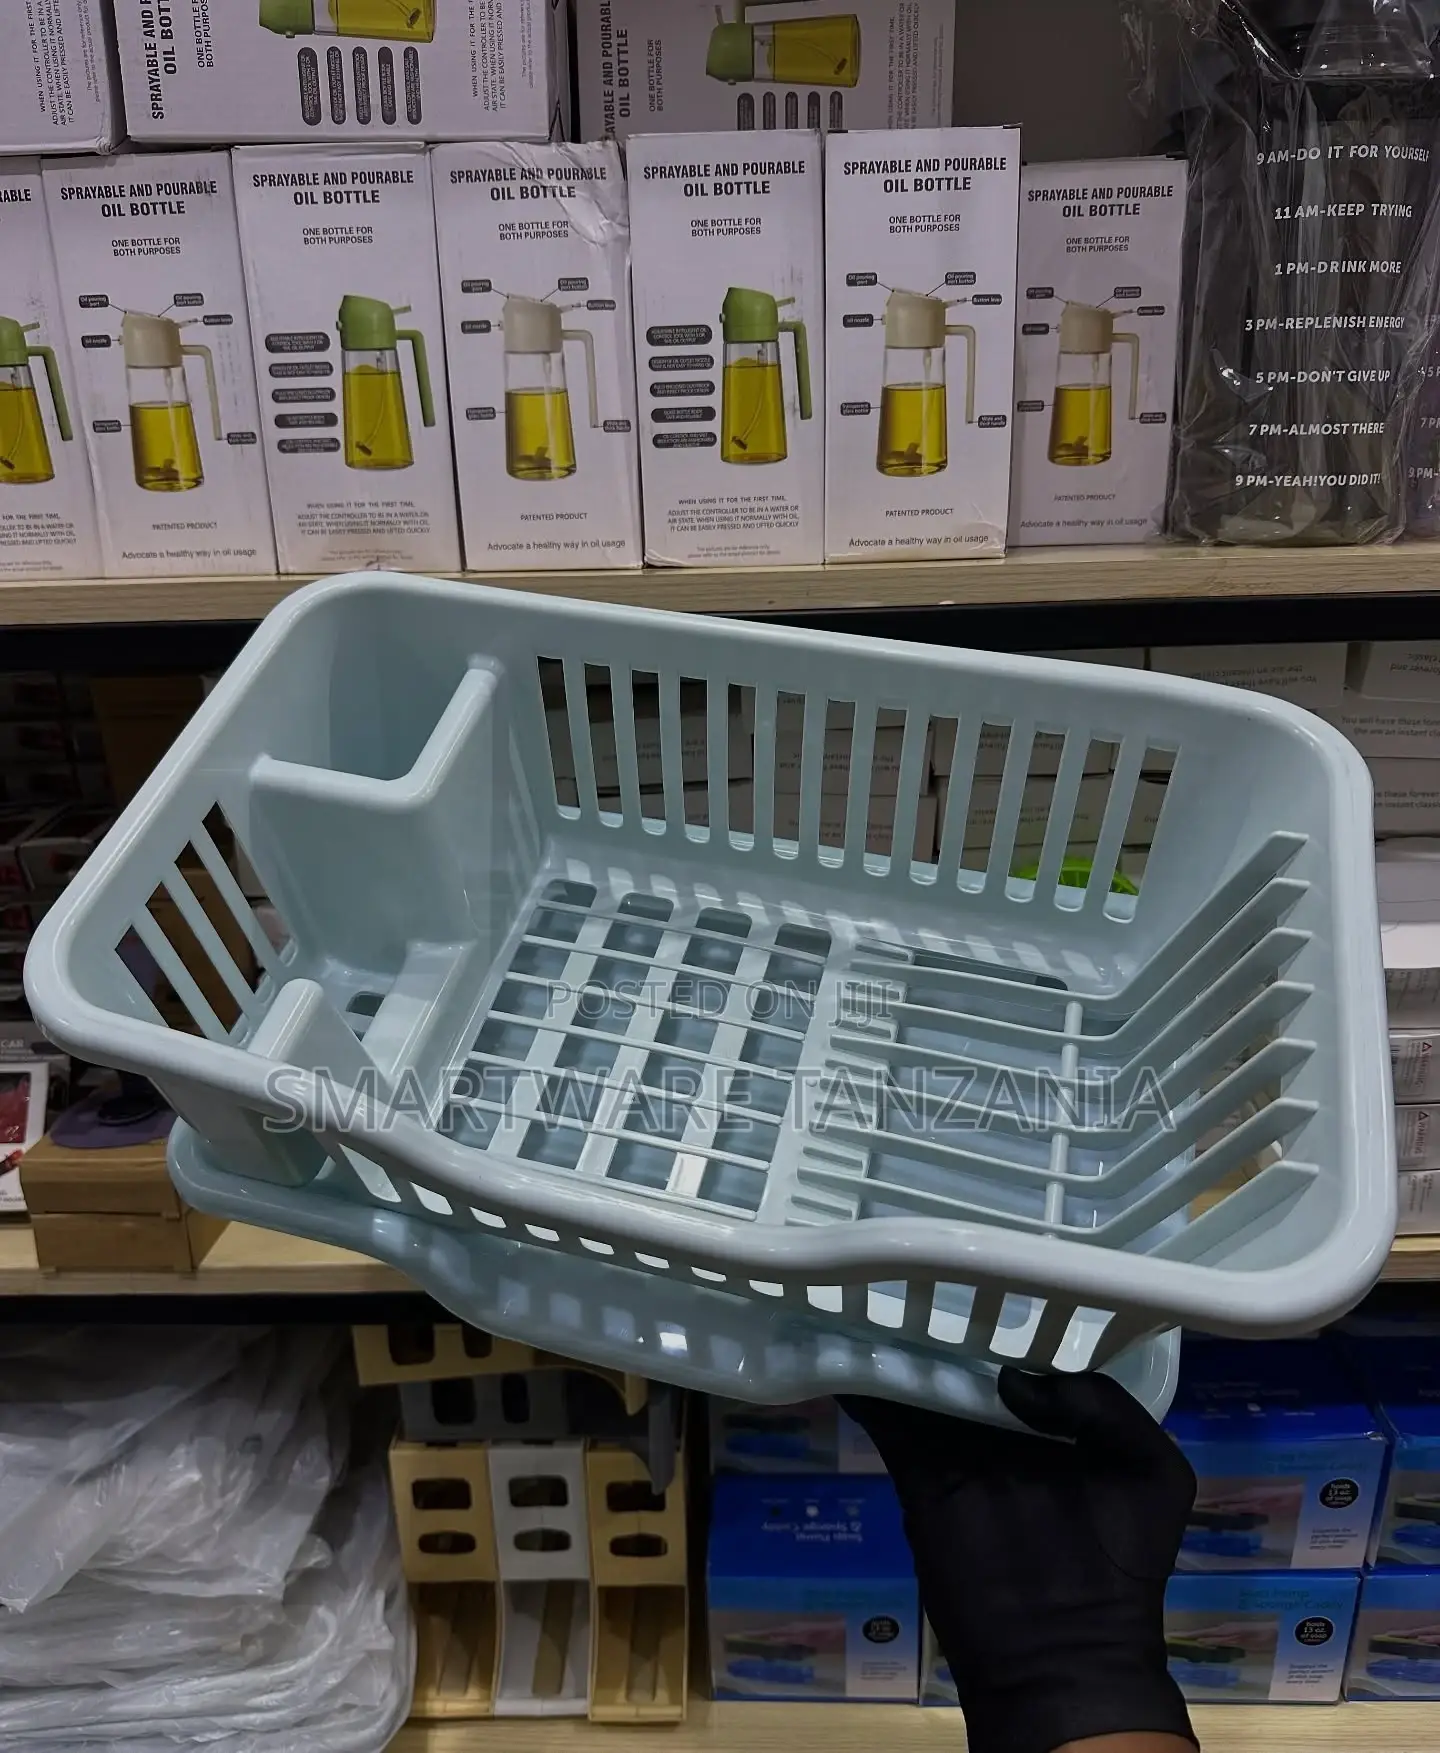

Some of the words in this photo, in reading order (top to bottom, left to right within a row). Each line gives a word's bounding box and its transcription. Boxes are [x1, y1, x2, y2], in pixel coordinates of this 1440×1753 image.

[141, 9, 156, 38] AND
[192, 7, 203, 45] BOTTLE
[162, 45, 177, 75] OIL
[196, 47, 205, 68] ONE
[204, 40, 214, 68] BOTH
[617, 29, 630, 88] BOTTLE
[655, 39, 664, 87] PURPOSES
[144, 42, 165, 120] SPRAYABLE
[602, 61, 614, 87] AND
[618, 92, 631, 118] OIL
[656, 88, 664, 112] BOTH
[1257, 153, 1264, 165] 9
[1267, 147, 1321, 164] AM-DO
[1328, 146, 1344, 158] IT
[1350, 145, 1378, 158] FOR
[1384, 146, 1429, 162] YOURSELF
[643, 164, 711, 180] SPRAYABLE
[715, 163, 739, 177] AND
[743, 161, 805, 176] POURABLE
[843, 160, 912, 175] SPRAYABLE
[916, 158, 940, 173] AND
[944, 157, 1007, 172] POURABLE
[252, 173, 319, 187] SPRAYABLE
[323, 172, 347, 186] AND
[351, 170, 414, 184] POURABLE
[450, 168, 516, 184] SPRAYABLE
[521, 168, 544, 181] AND
[548, 167, 607, 181] POURABLE
[61, 185, 126, 200] SPRAYABLE
[130, 183, 153, 197] AND
[156, 181, 217, 196] POURABLE
[684, 183, 708, 197] OIL
[713, 181, 771, 196] BOTTLE
[883, 179, 908, 193] OIL
[913, 177, 972, 192] BOTTLE
[293, 191, 318, 205] OIL
[323, 190, 380, 205] BOTTLE
[490, 187, 515, 201] OIL
[520, 186, 576, 199] BOTTLE
[1028, 188, 1088, 202] SPRAYABLE
[1091, 187, 1113, 200] AND
[1116, 186, 1173, 198] POURABLE
[101, 203, 126, 217] OIL
[130, 201, 186, 216] BOTTLE
[1063, 206, 1084, 218] OIL
[1089, 203, 1140, 216] BOTTLE
[1274, 207, 1291, 220] 11
[1294, 204, 1365, 218] AM-KEEP
[1371, 204, 1413, 218] TRYING
[499, 223, 516, 232] ONE
[518, 222, 549, 230] BOTTLE
[552, 221, 569, 229] FOR
[711, 219, 743, 227] BOTTLE
[889, 216, 907, 224] ONE
[909, 215, 941, 223] BOTTLE
[943, 214, 961, 222] FOR
[302, 228, 320, 236] ONE
[322, 227, 354, 235] BOTTLE
[356, 226, 373, 234] FOR
[500, 233, 522, 241] BOTH
[524, 230, 569, 239] PURPOSES
[691, 229, 714, 237] BOTH
[716, 227, 761, 236] PURPOSES
[889, 225, 913, 233] BOTH
[914, 224, 960, 232] PURPOSES
[112, 239, 129, 247] ONE
[131, 238, 162, 247] BOTTLE
[164, 237, 181, 245] FOR
[304, 237, 327, 245] BOTH
[328, 236, 373, 244] PURPOSES
[1066, 237, 1082, 245] ONE
[1084, 236, 1113, 244] BOTTLE
[1088, 244, 1129, 252] PURPOSES
[113, 248, 136, 256] BOTH
[138, 247, 181, 256] PURPOSES
[1275, 264, 1283, 275] 1
[1286, 260, 1367, 274] PM-DRINK
[1369, 261, 1402, 273] MORE
[1245, 319, 1253, 331] 3
[1256, 316, 1366, 331] PM-REPLENISH
[1369, 316, 1405, 329] ENERGY
[1256, 372, 1264, 384] 5
[1267, 370, 1345, 383] PM-DON'T
[1347, 369, 1376, 382] GIVE
[1378, 369, 1391, 382] UP
[1249, 424, 1258, 435] 7
[1260, 423, 1349, 436] PM-ALMOST
[1352, 422, 1385, 434] THERE
[1235, 475, 1243, 487] 9
[1246, 473, 1347, 487] PM-YEAH!YOU
[1349, 473, 1368, 485] DID
[1370, 473, 1381, 484] IT!
[520, 513, 554, 521] PATENTED
[555, 512, 588, 520] PRODUCT
[488, 542, 523, 551] Advocate
[533, 541, 561, 550] healthy
[564, 542, 579, 550] way
[581, 540, 589, 548] in
[591, 540, 599, 548] oil
[602, 540, 625, 548] usage
[849, 538, 885, 547] Advocate
[895, 537, 923, 546] healthy
[926, 537, 942, 545] way
[954, 535, 963, 543] oil
[965, 535, 989, 544] usage
